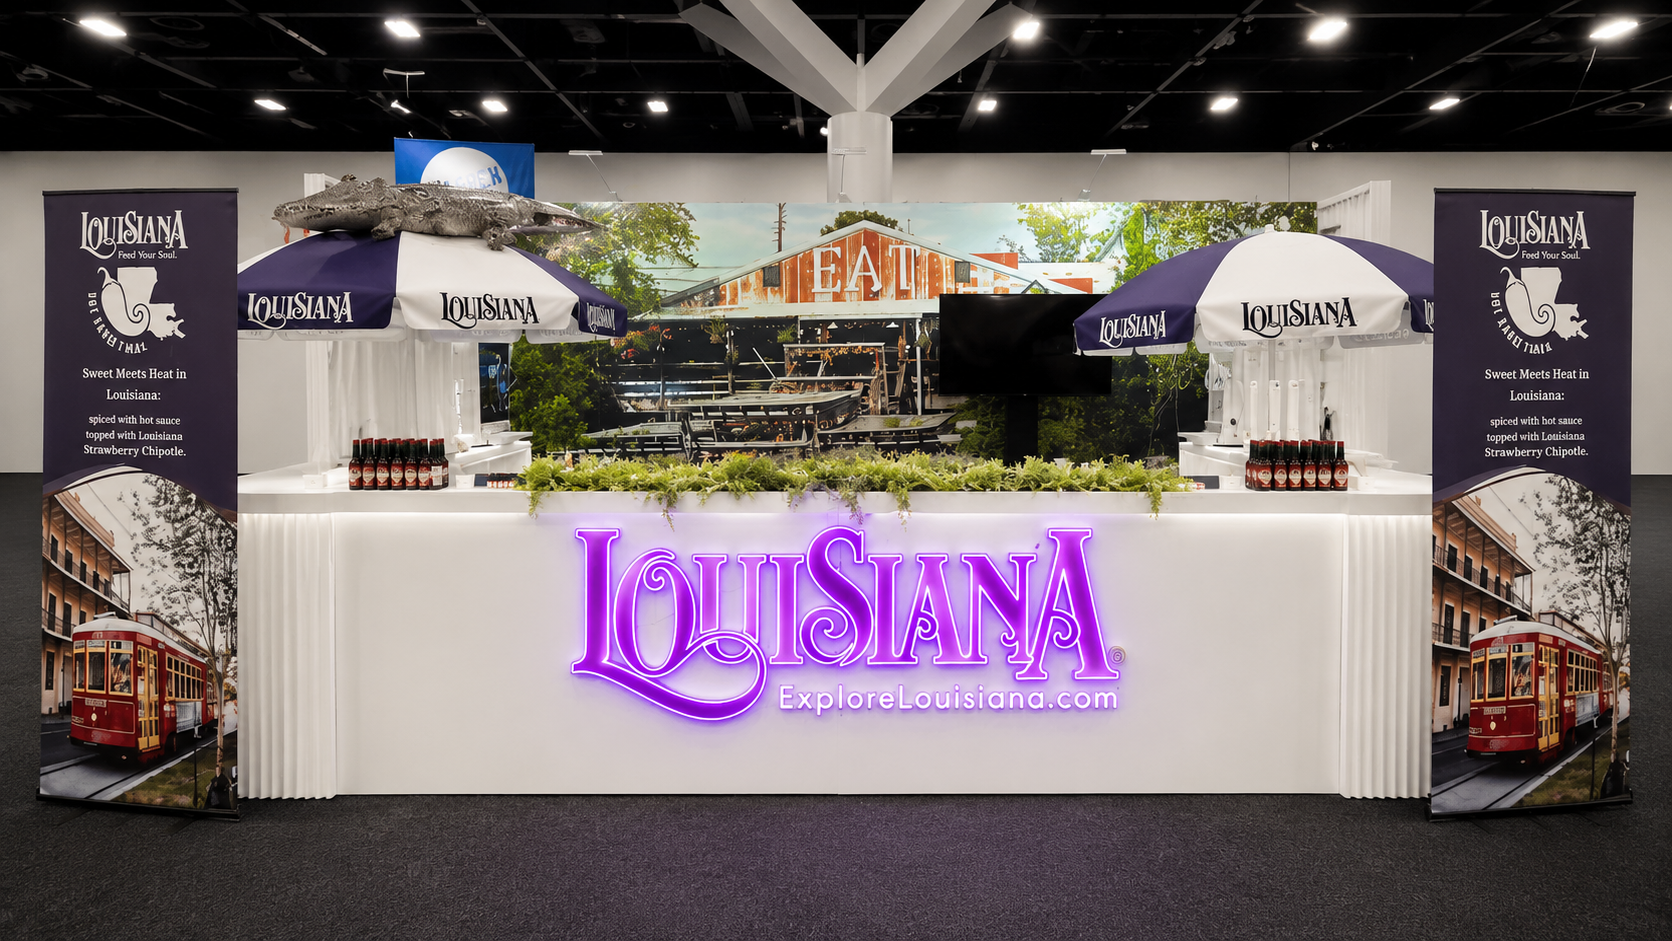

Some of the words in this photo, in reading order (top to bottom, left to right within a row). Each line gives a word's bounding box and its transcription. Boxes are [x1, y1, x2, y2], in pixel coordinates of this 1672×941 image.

[79, 210, 188, 259] LOUISIANA
[1479, 209, 1590, 259] LOUISIANA
[118, 250, 136, 259] Feed
[138, 250, 156, 259] Your
[158, 250, 178, 259] Soul.
[1542, 250, 1560, 259] Your
[1561, 250, 1581, 260] Soul.
[811, 245, 921, 293] EAT
[247, 291, 354, 329] LOUISIANA
[439, 291, 540, 329] LOUISIANA
[1240, 297, 1358, 339] LOUISIANA
[1098, 310, 1167, 348] LOUISIANA
[82, 367, 114, 379] Sweet
[116, 368, 147, 379] Meets
[149, 368, 174, 379] Heat
[176, 368, 187, 379] in
[1484, 368, 1517, 380] Sweet
[1519, 368, 1551, 380] Meets
[1553, 368, 1577, 379] Heat
[1579, 368, 1589, 379] in
[106, 388, 161, 401] Louisiana:
[1510, 390, 1565, 401] Louisiana:
[88, 414, 116, 426] spiced
[118, 415, 137, 425] with
[139, 415, 154, 425] hot
[155, 417, 181, 426] sauce
[1490, 416, 1519, 428] spiced
[1520, 416, 1541, 426] with
[1558, 417, 1584, 425] sauce
[85, 430, 115, 442] topped
[117, 430, 136, 440] with
[138, 430, 183, 441] Louisiana
[1486, 432, 1518, 445] topped
[1520, 432, 1540, 441] with
[1541, 431, 1585, 441] Louisiana
[83, 444, 140, 458] Strawberry
[141, 445, 187, 459] Chipotle.
[1484, 447, 1543, 459] Strawberry
[1545, 446, 1589, 459] Chipotle.
[571, 526, 1121, 722] LOUISIANA
[779, 683, 1119, 717] ExploreLouisiana.com
